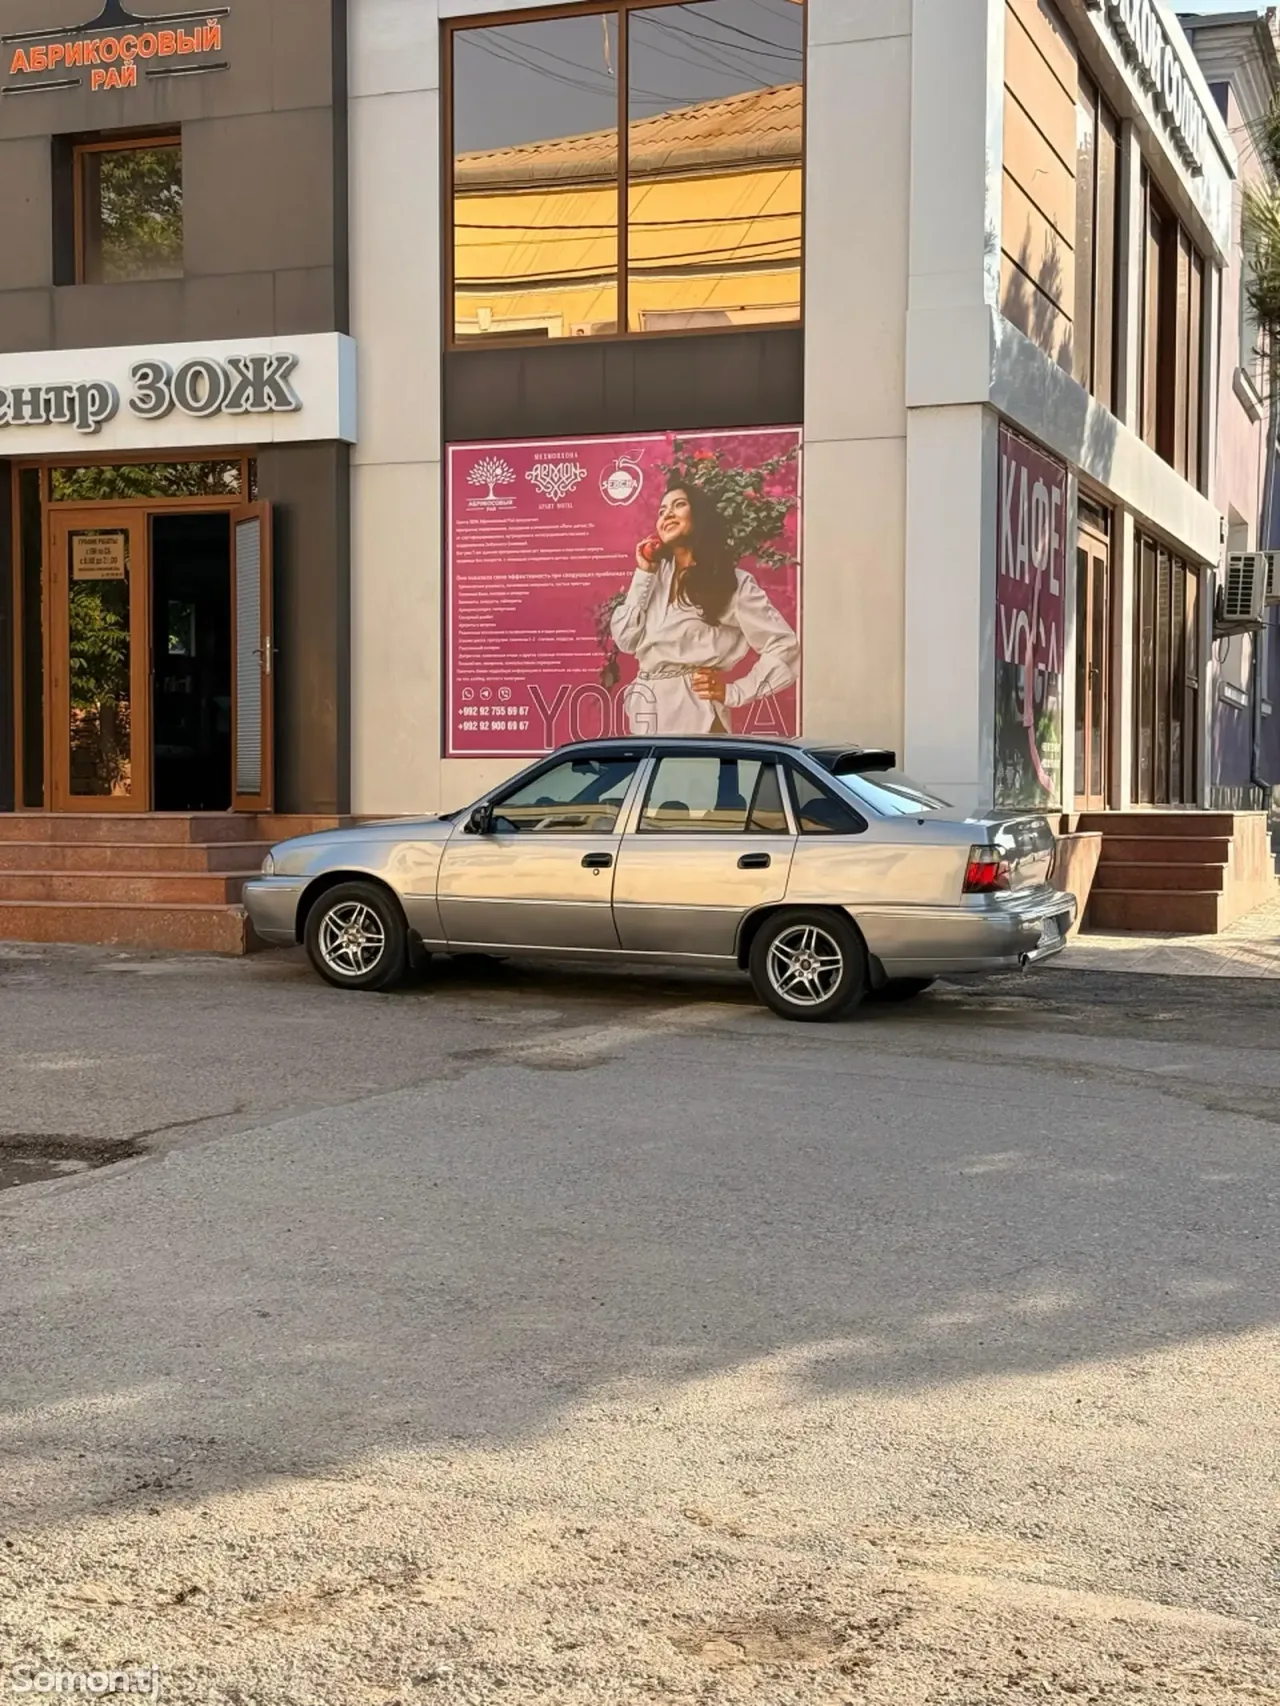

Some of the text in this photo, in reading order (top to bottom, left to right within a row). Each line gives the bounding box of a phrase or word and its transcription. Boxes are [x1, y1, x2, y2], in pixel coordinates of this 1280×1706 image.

[10, 18, 222, 74] АБРИКОСОВЫЙ
[91, 59, 137, 91] РАЙ
[129, 352, 302, 419] ЗОЖ
[1001, 454, 1060, 596] КАФЕ
[458, 706, 478, 716] +992
[480, 706, 490, 716] 92
[491, 706, 506, 716] 755
[458, 721, 478, 731] +992
[480, 721, 490, 731] 92
[491, 721, 506, 731] 900
